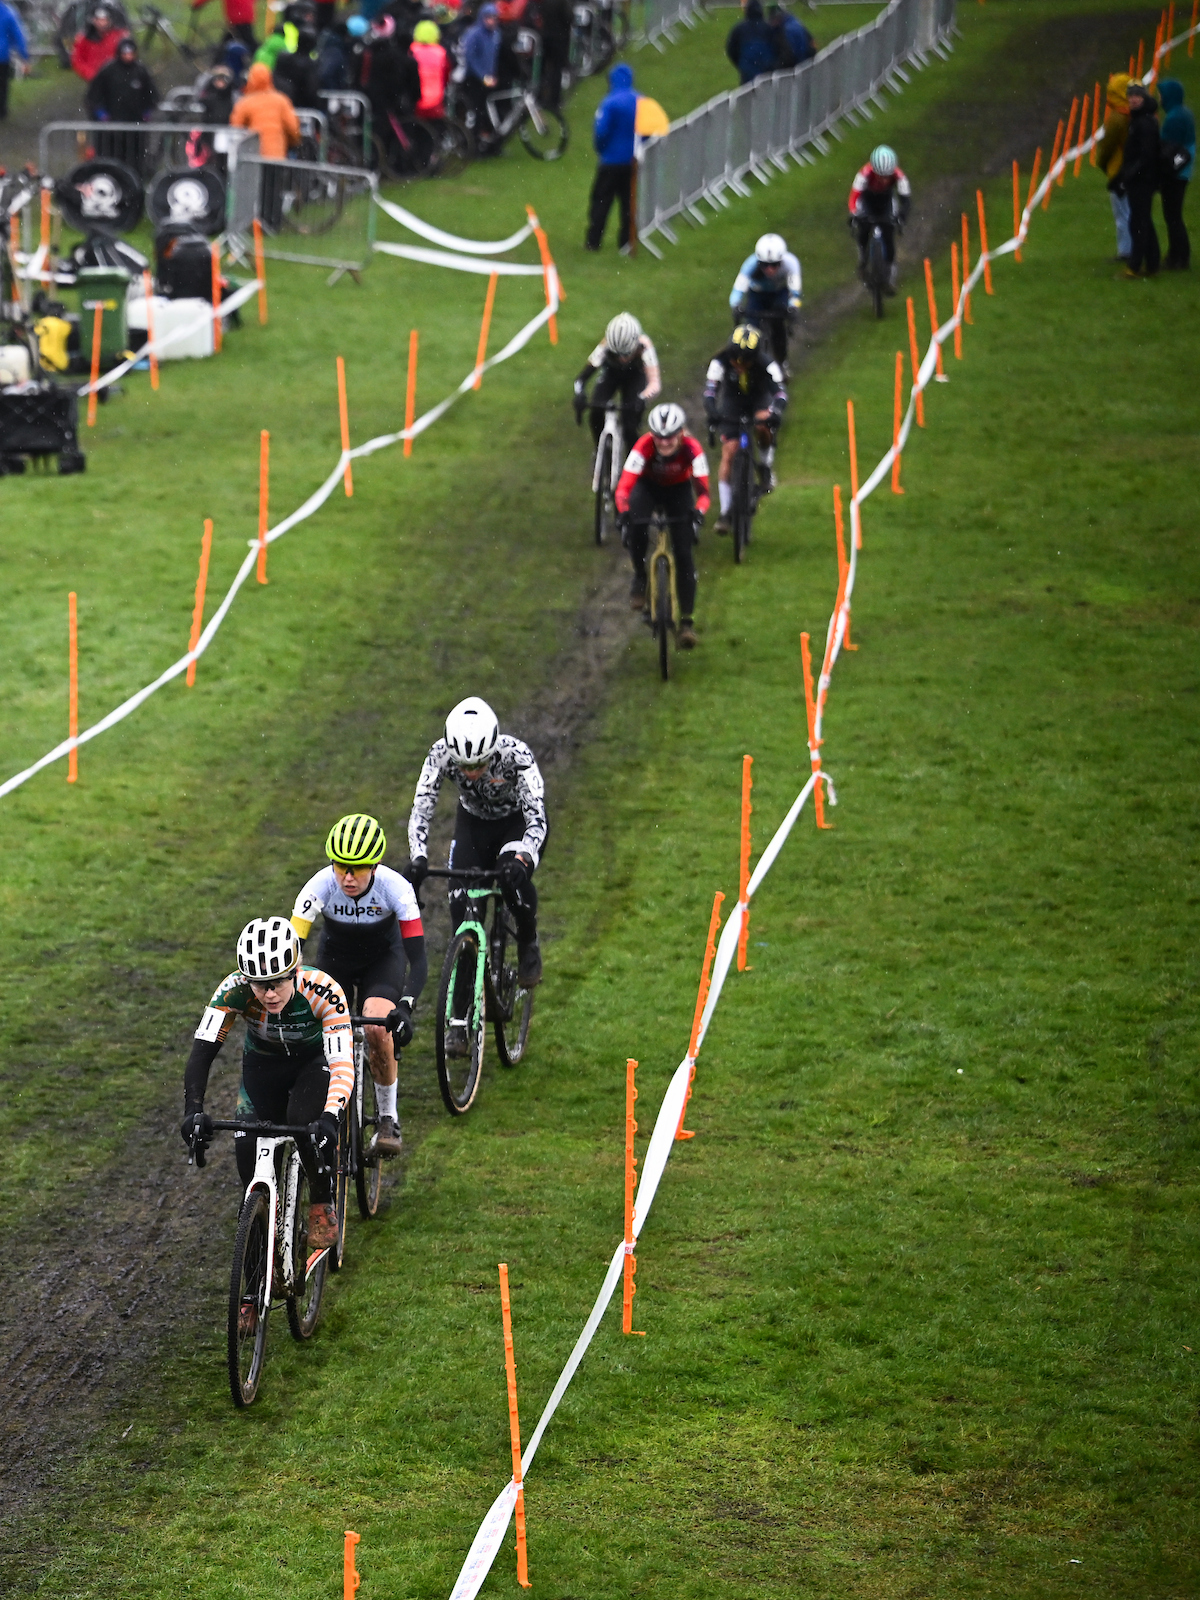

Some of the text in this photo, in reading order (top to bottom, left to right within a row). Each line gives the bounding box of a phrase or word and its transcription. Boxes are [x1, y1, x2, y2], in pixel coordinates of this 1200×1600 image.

[301, 899, 312, 915] 9
[302, 977, 346, 1015] wahoo
[327, 1036, 342, 1054] 11
